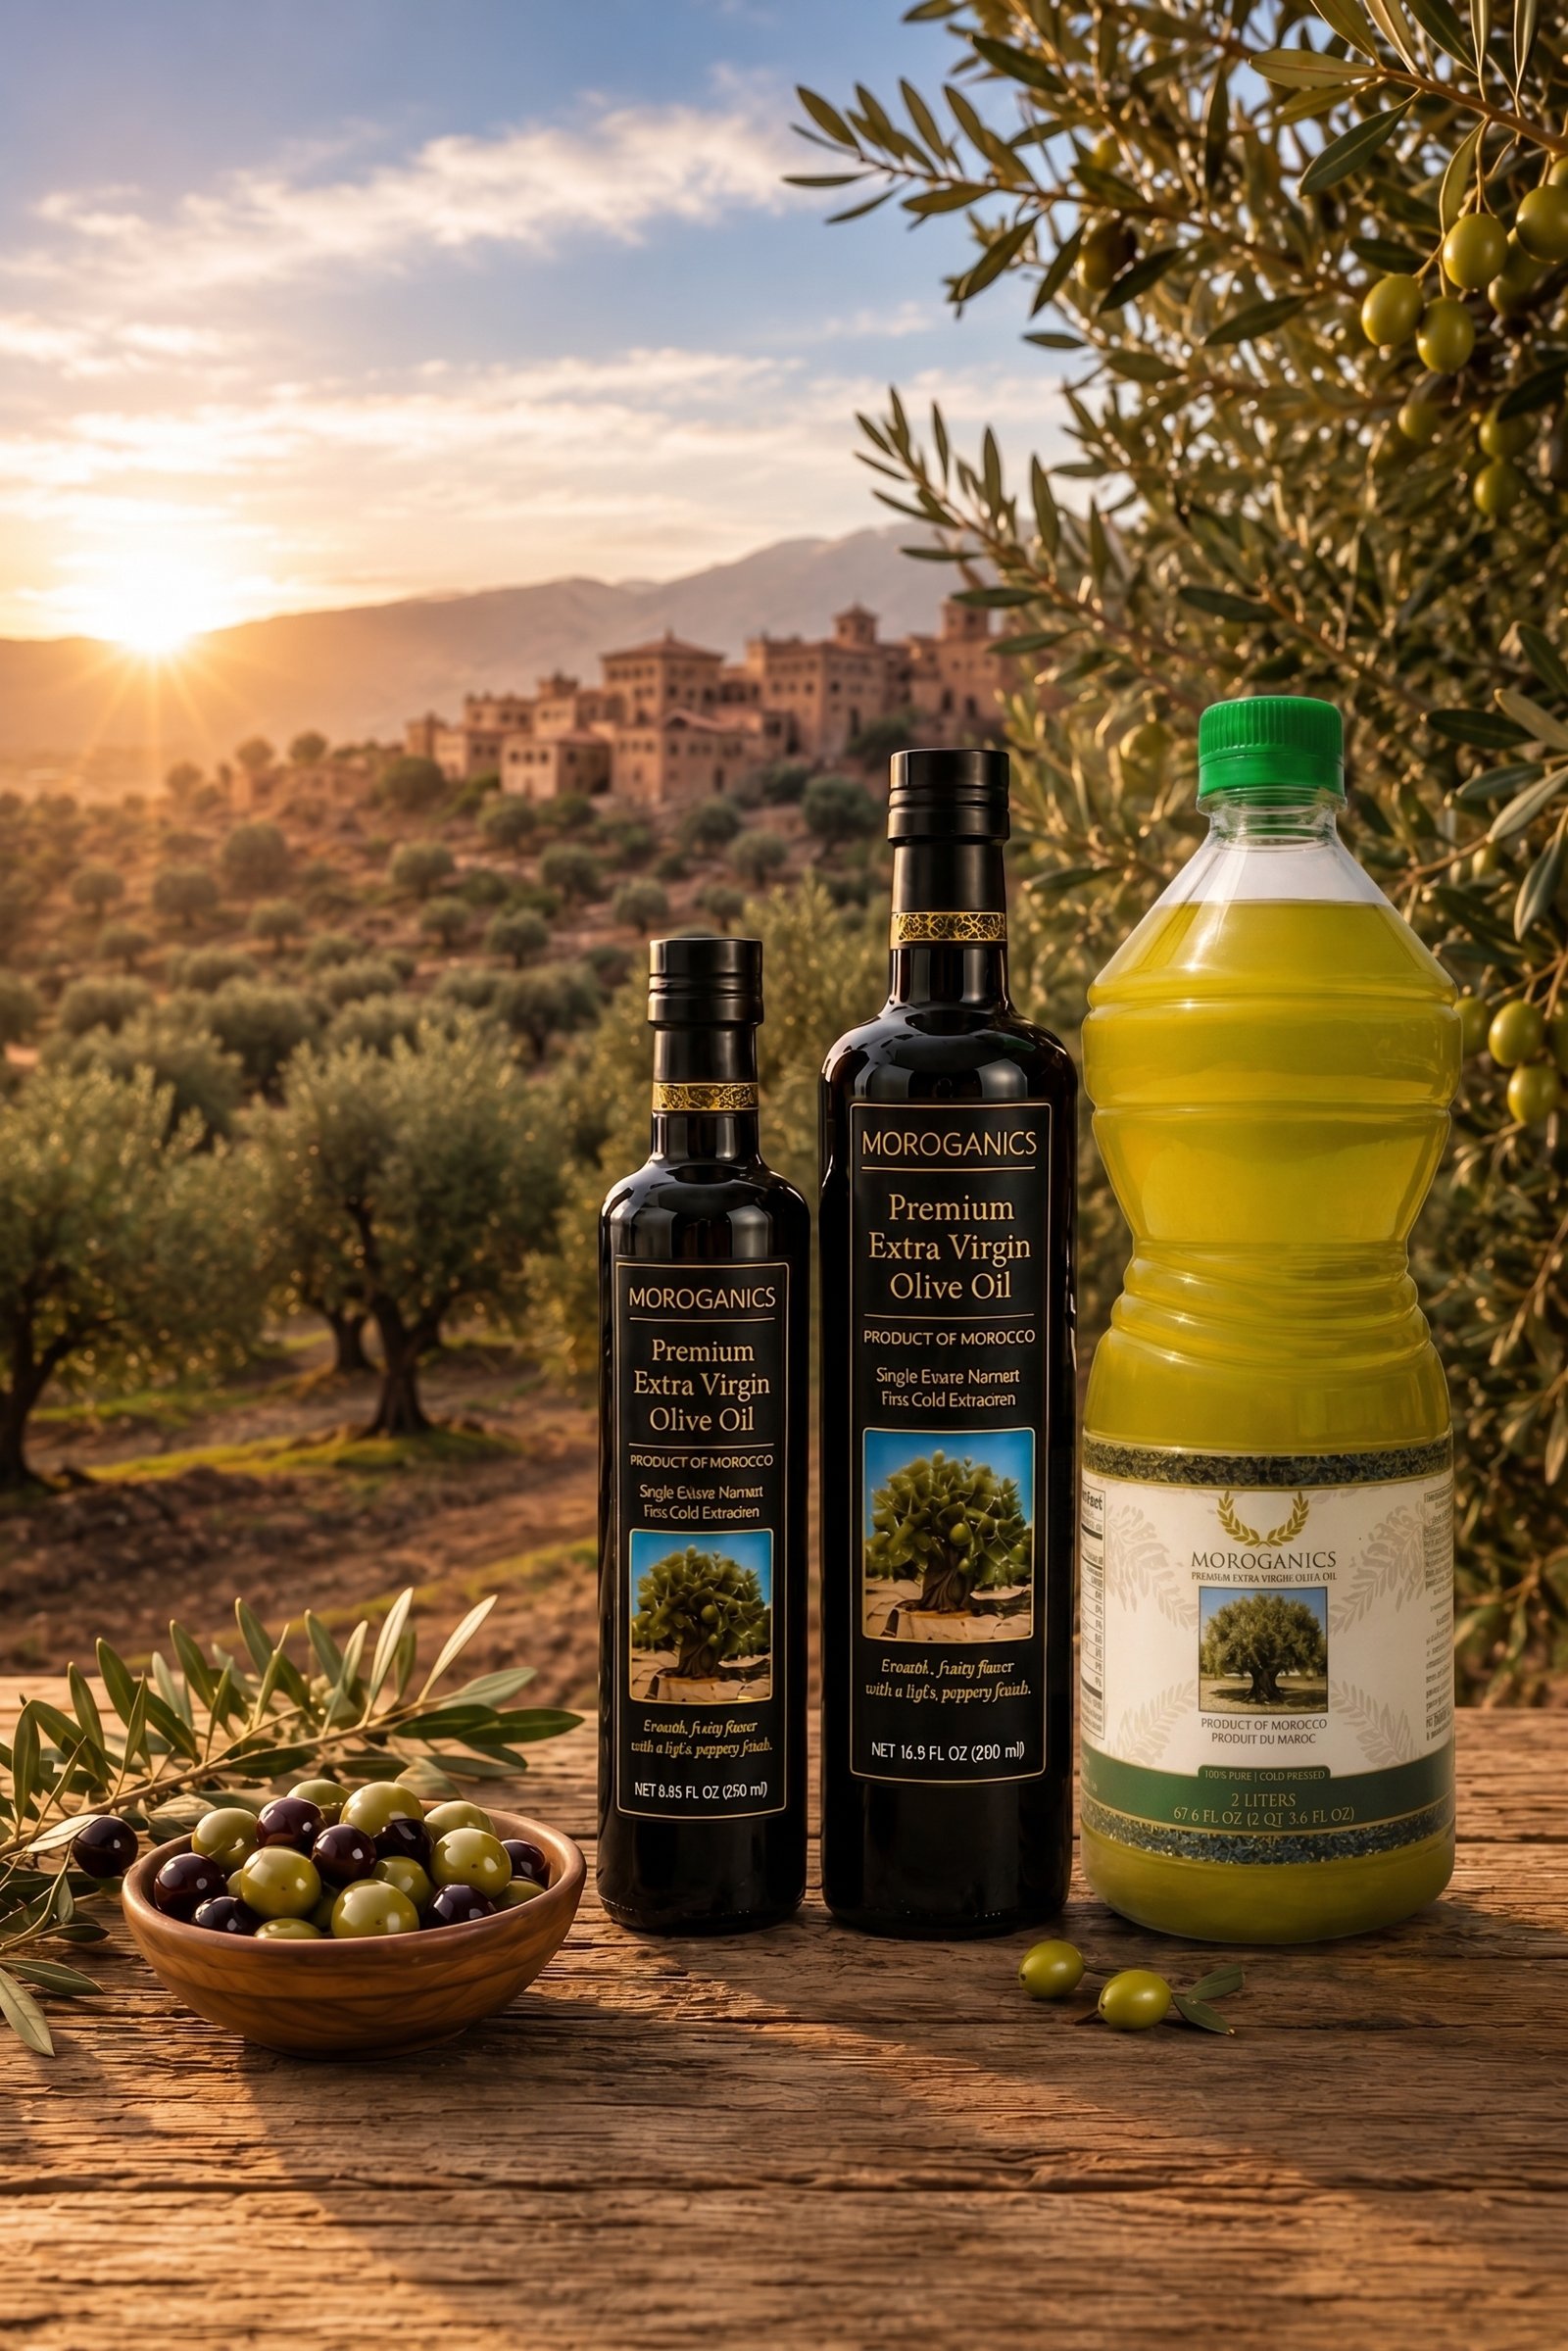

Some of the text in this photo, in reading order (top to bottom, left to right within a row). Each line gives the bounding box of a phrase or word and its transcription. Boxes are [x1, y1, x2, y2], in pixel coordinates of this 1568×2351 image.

[861, 1130, 1038, 1156] MOROGANICS
[888, 1194, 1015, 1221] Premium
[868, 1232, 1031, 1268] Extra Virgin
[890, 1271, 1011, 1299] Olive Oil
[629, 1287, 776, 1309] MOROGANICS
[863, 1329, 1036, 1346] PRODUCT OF MOROCCO
[652, 1339, 755, 1362] Premium
[633, 1370, 770, 1402] Extra Virgin
[876, 1366, 918, 1388] Single
[911, 1392, 946, 1407] Cold
[650, 1406, 755, 1432] Olive Oil
[630, 1454, 774, 1469] PRODUCT OF MOROCCO
[669, 1505, 699, 1519] Cold
[1191, 1551, 1337, 1569] MOROGANICS
[1233, 1574, 1259, 1583] EXTRA
[1322, 1572, 1338, 1581] OIL
[865, 1682, 893, 1697] with
[895, 1689, 903, 1698] a
[1201, 1718, 1327, 1731] PRODUCT OF MOROCCO
[1212, 1733, 1316, 1744] PRODUIT DU MAROC
[656, 1743, 663, 1754] a
[871, 1741, 896, 1758] NET
[929, 1745, 945, 1761] FL
[948, 1745, 968, 1761] OZ
[1004, 1741, 1025, 1760] ml)
[1229, 1771, 1252, 1781] PURE
[1259, 1772, 1285, 1782] COLD
[1287, 1771, 1325, 1781] PRESSED
[634, 1782, 767, 1800] NET 8.85 FL OZ (250 ml)
[1231, 1793, 1297, 1807] 2 LITERS
[1203, 1809, 1218, 1824] FL
[1222, 1811, 1242, 1826] OZ
[1247, 1812, 1259, 1827] (2
[1263, 1812, 1284, 1828] QT
[1289, 1812, 1308, 1826] 3.6
[1312, 1811, 1328, 1824] FL
[1331, 1806, 1355, 1822] OZ)
